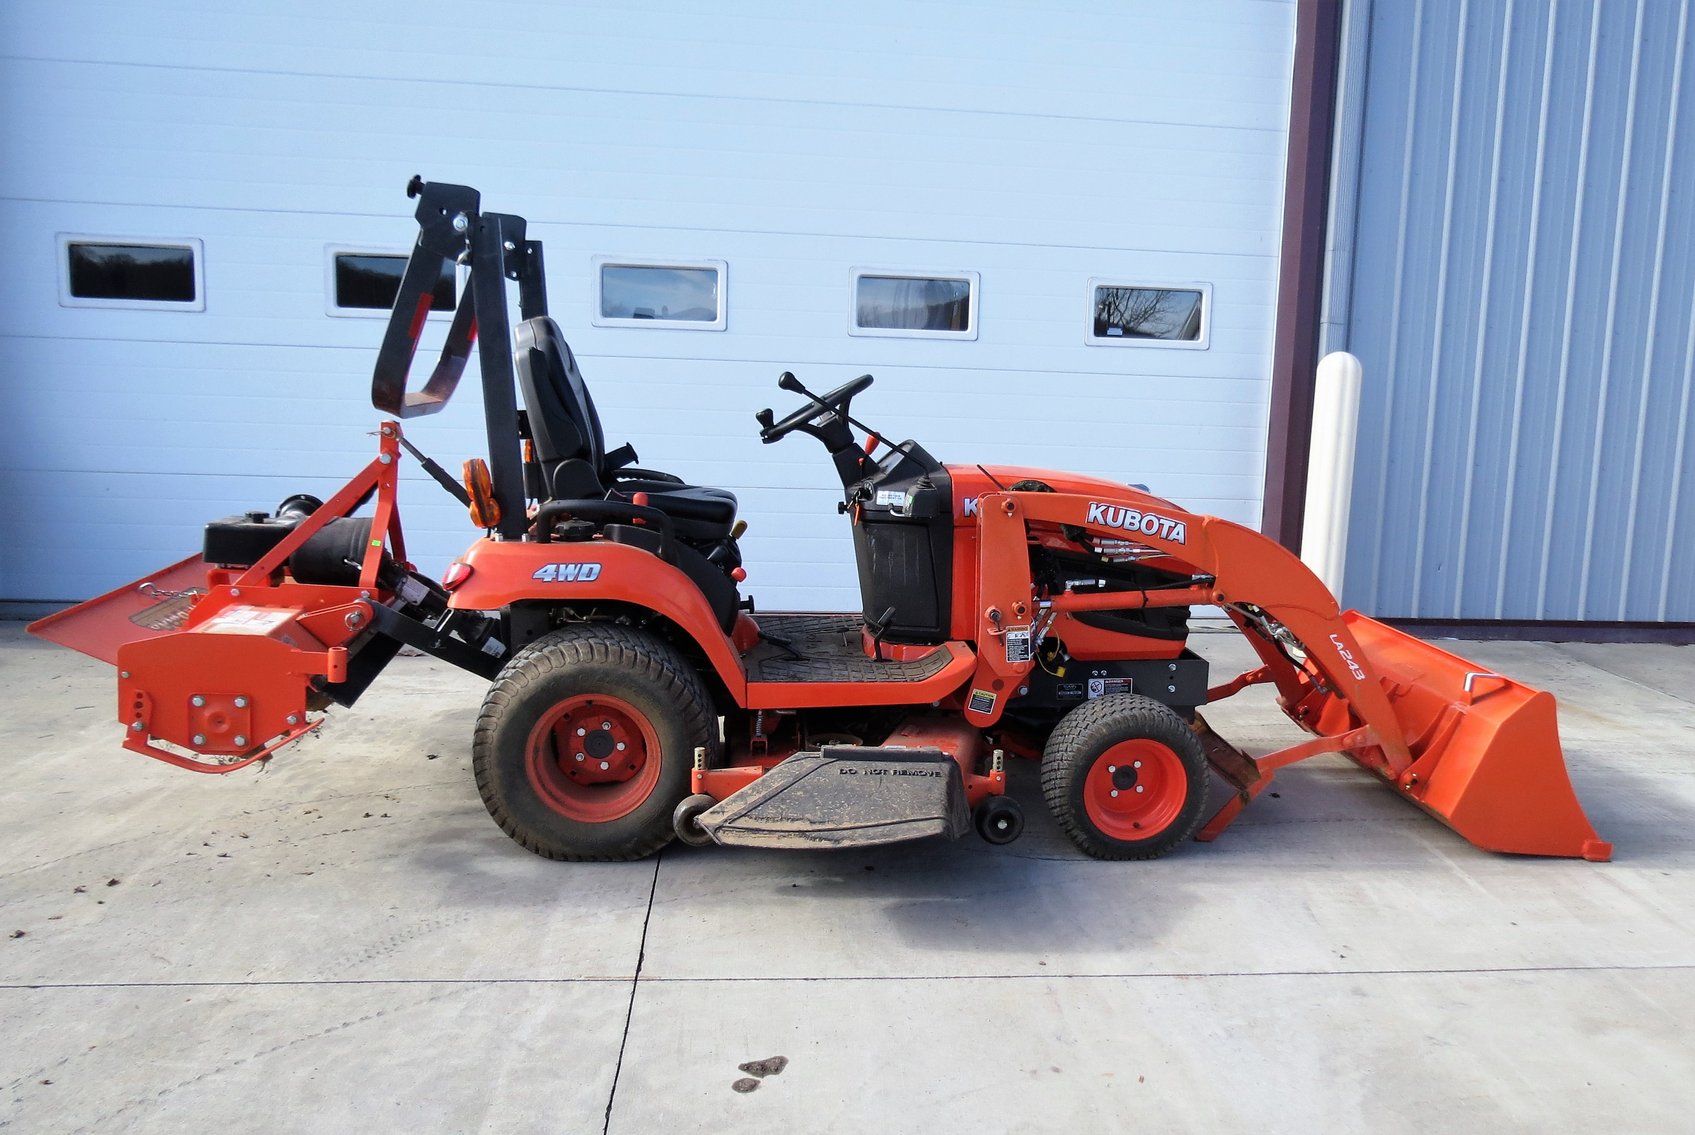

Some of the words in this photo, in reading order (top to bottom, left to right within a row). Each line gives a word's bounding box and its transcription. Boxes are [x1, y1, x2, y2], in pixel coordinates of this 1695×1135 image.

[1086, 502, 1187, 545] KUBOTA
[532, 562, 603, 583] 4WD
[1329, 634, 1366, 680] LA243
[893, 769, 942, 777] REMOVE
